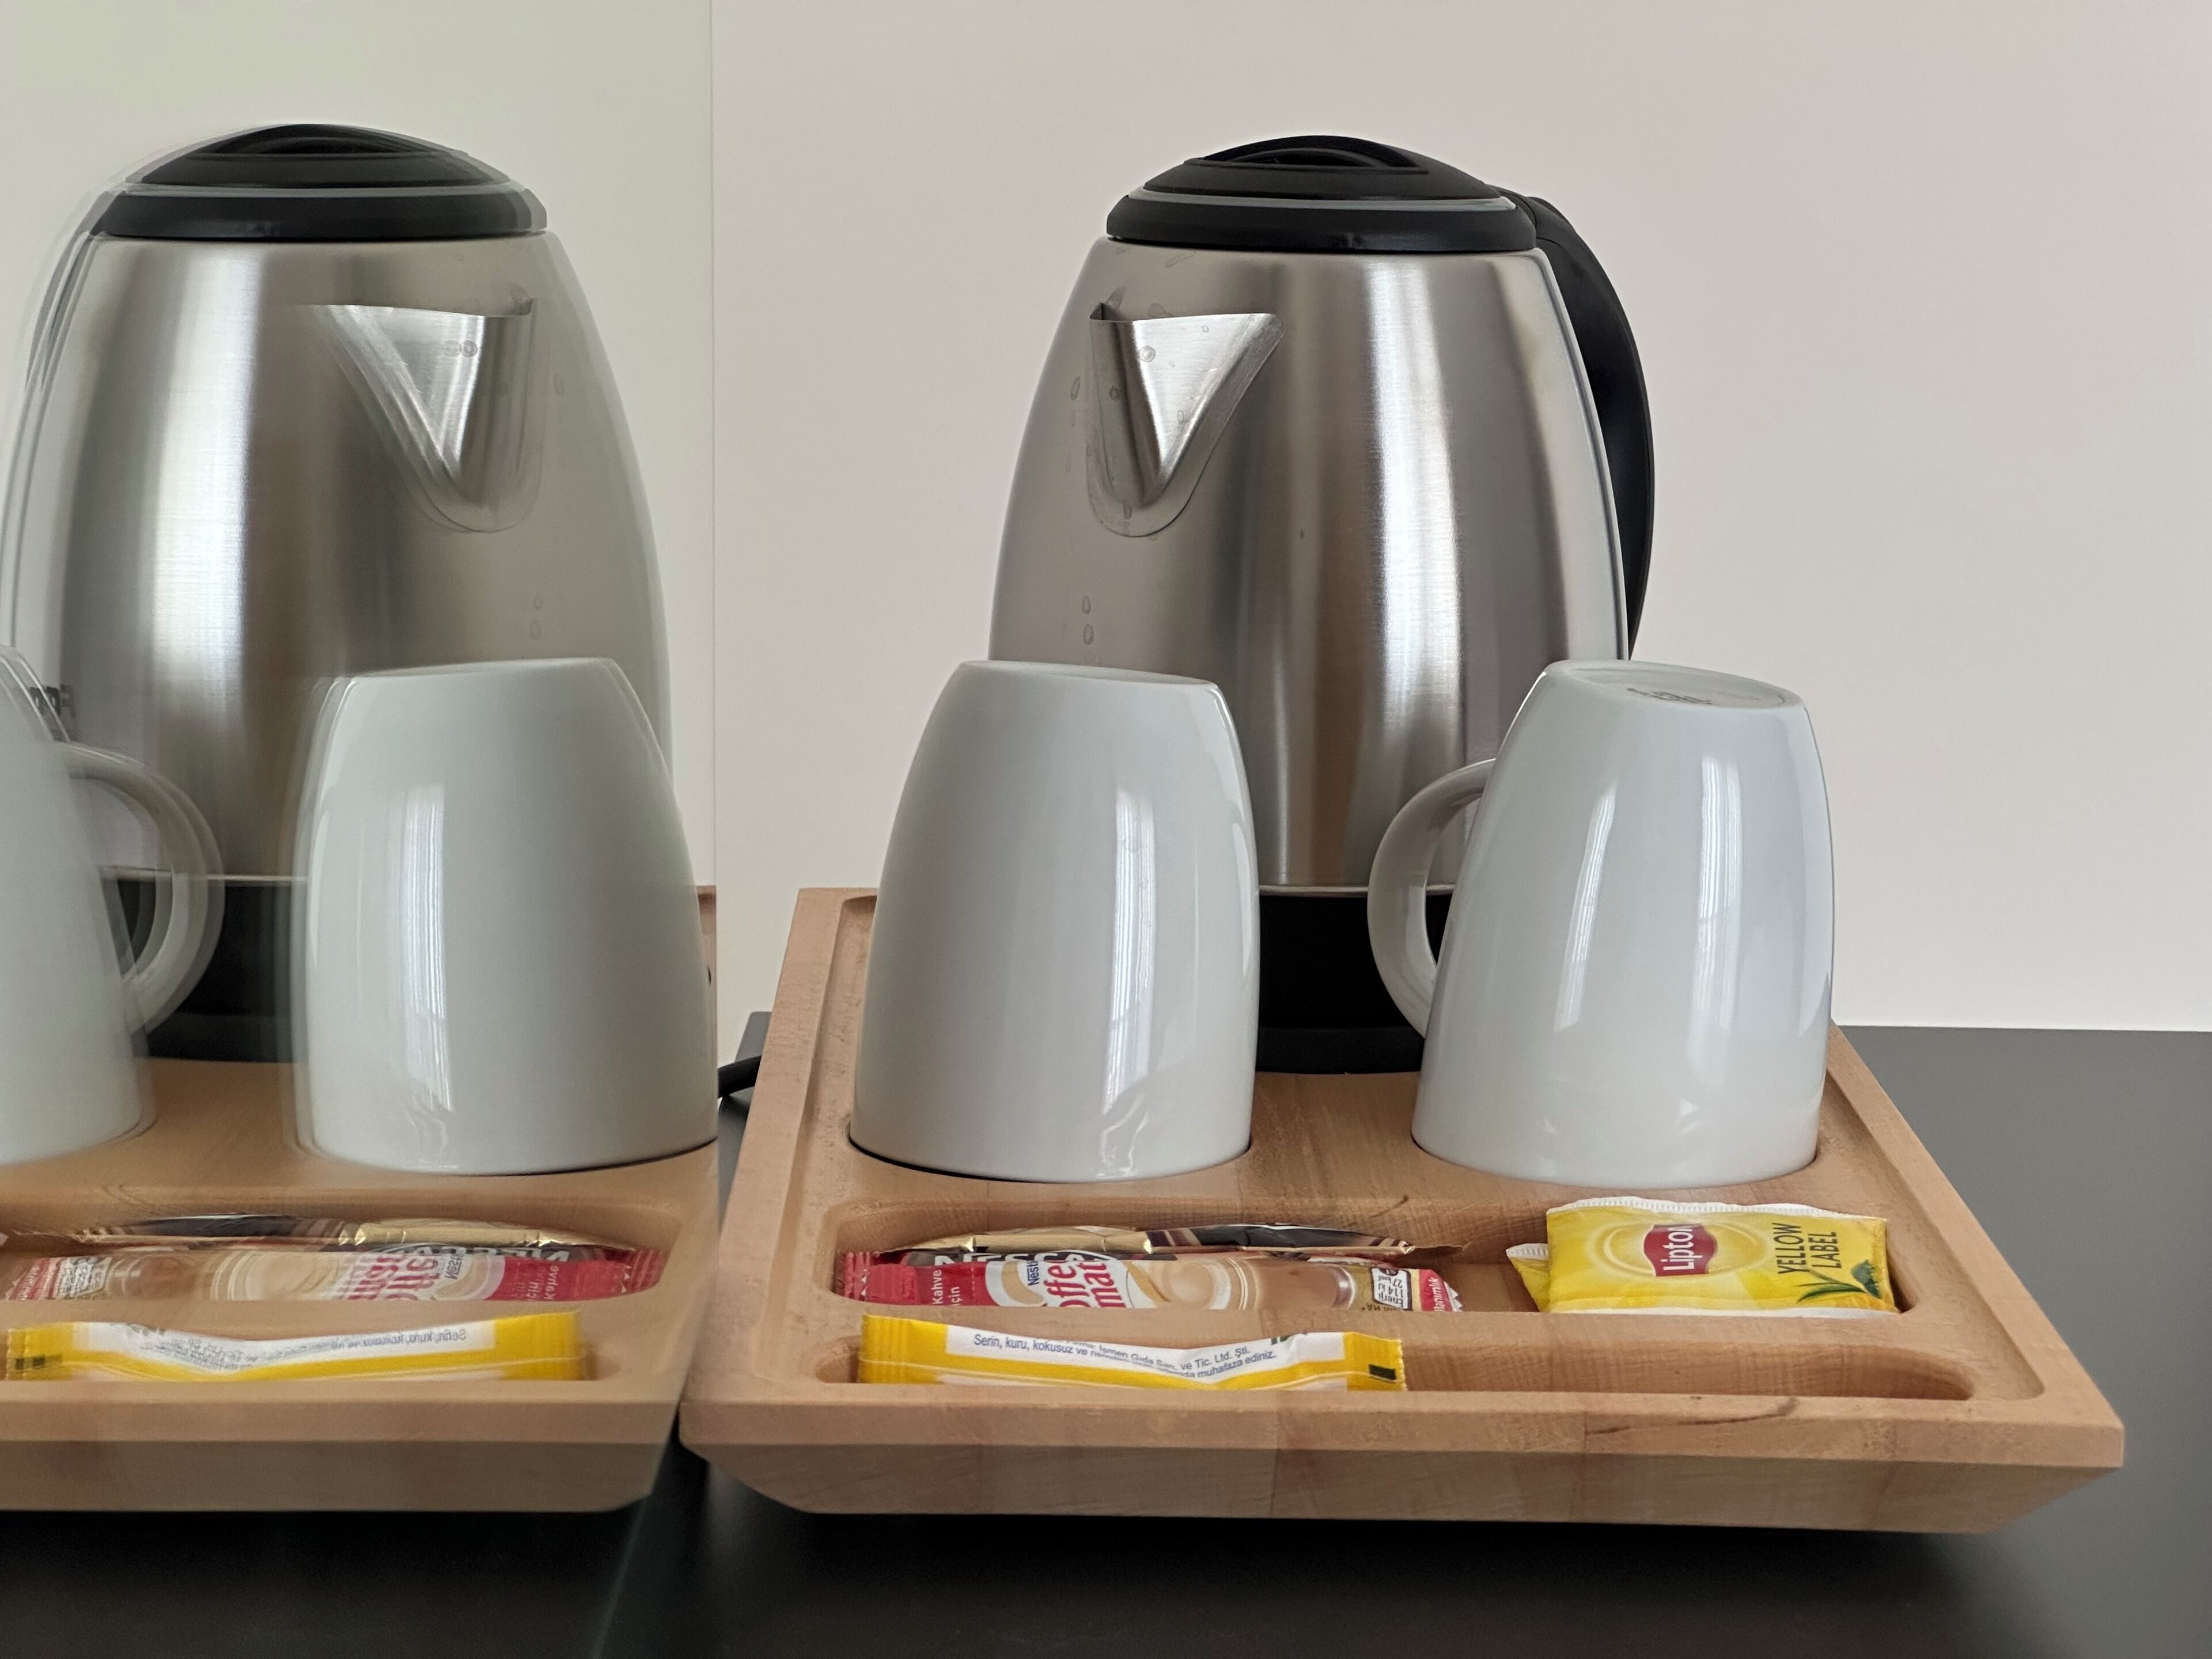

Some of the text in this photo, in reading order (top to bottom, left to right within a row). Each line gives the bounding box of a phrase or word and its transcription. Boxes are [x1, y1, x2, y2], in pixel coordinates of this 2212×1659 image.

[1660, 1226, 1703, 1271] Lipton
[1772, 1222, 1810, 1274] YELLOW
[1808, 1232, 1842, 1268] LABEL
[931, 1269, 943, 1305] Kahve
[1388, 1286, 1403, 1298] 114
[1392, 1278, 1403, 1289] 27
[974, 1334, 1002, 1349] Serin,
[1006, 1337, 1030, 1351] kuru,
[1033, 1339, 1073, 1354] kokusuz
[1198, 1360, 1243, 1378] muhafaza
[1245, 1351, 1277, 1365] ediniz.
[1195, 1358, 1213, 1368] Tic.
[1214, 1352, 1233, 1363] Ltd.
[1235, 1346, 1251, 1358] Şti.
